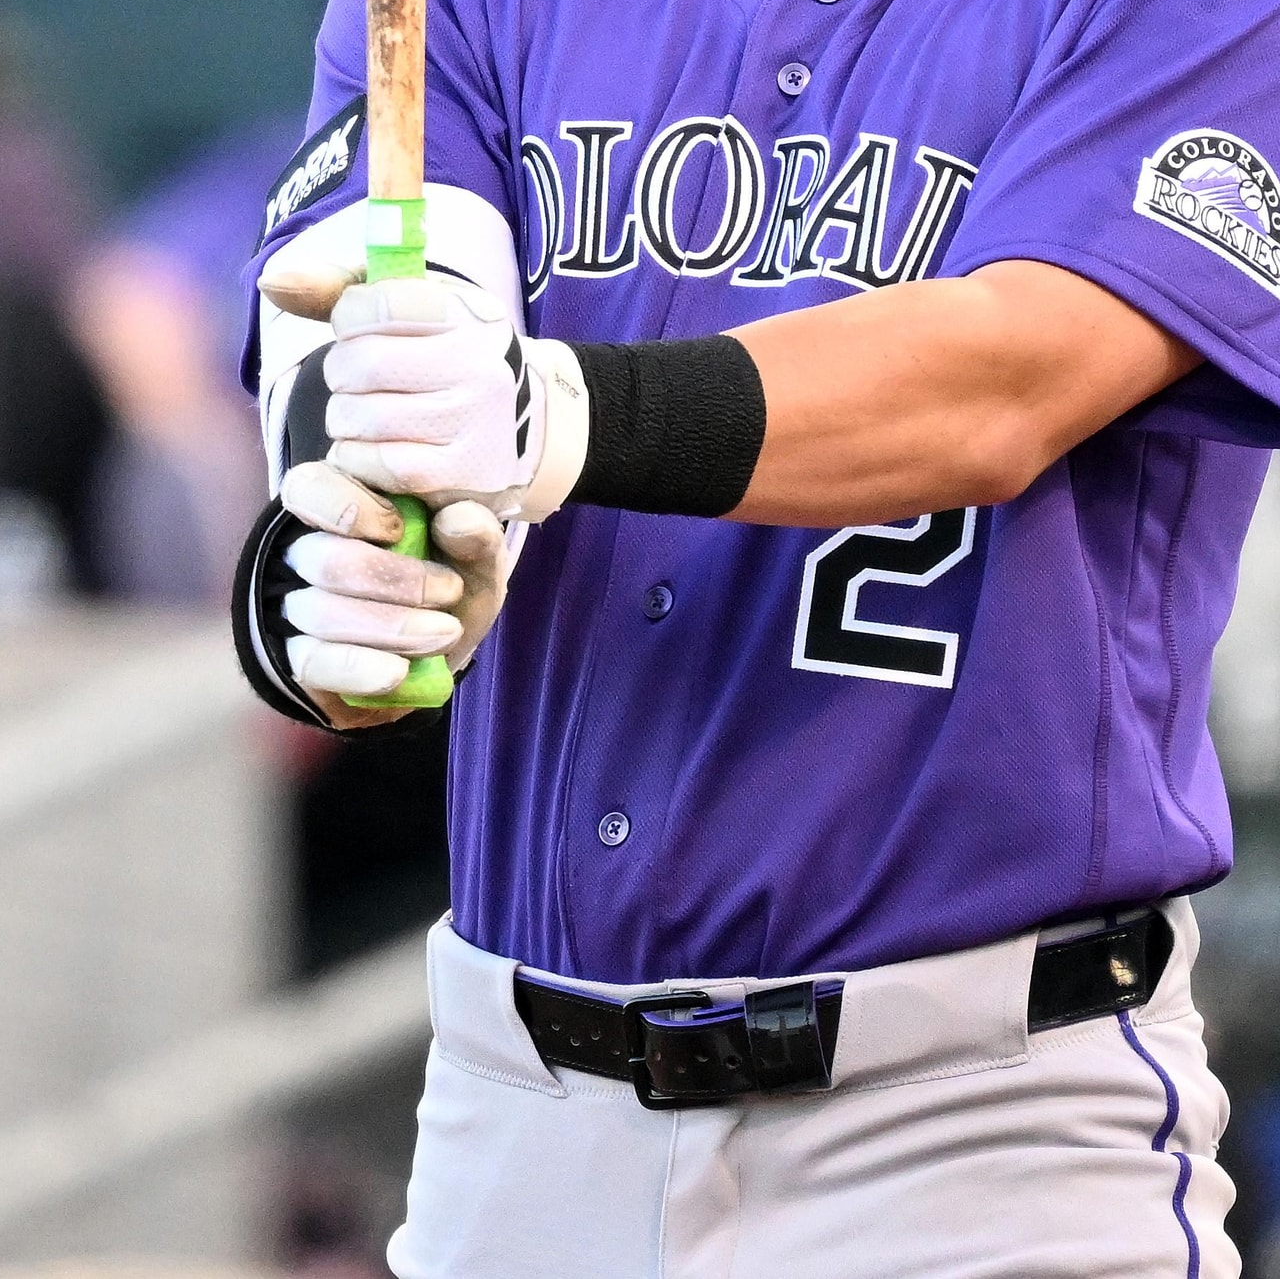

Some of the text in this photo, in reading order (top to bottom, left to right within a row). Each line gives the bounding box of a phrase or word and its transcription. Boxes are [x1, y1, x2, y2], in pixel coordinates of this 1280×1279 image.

[265, 114, 359, 236] YORK
[291, 154, 349, 212] SYSTEMS
[790, 506, 978, 690] 2
